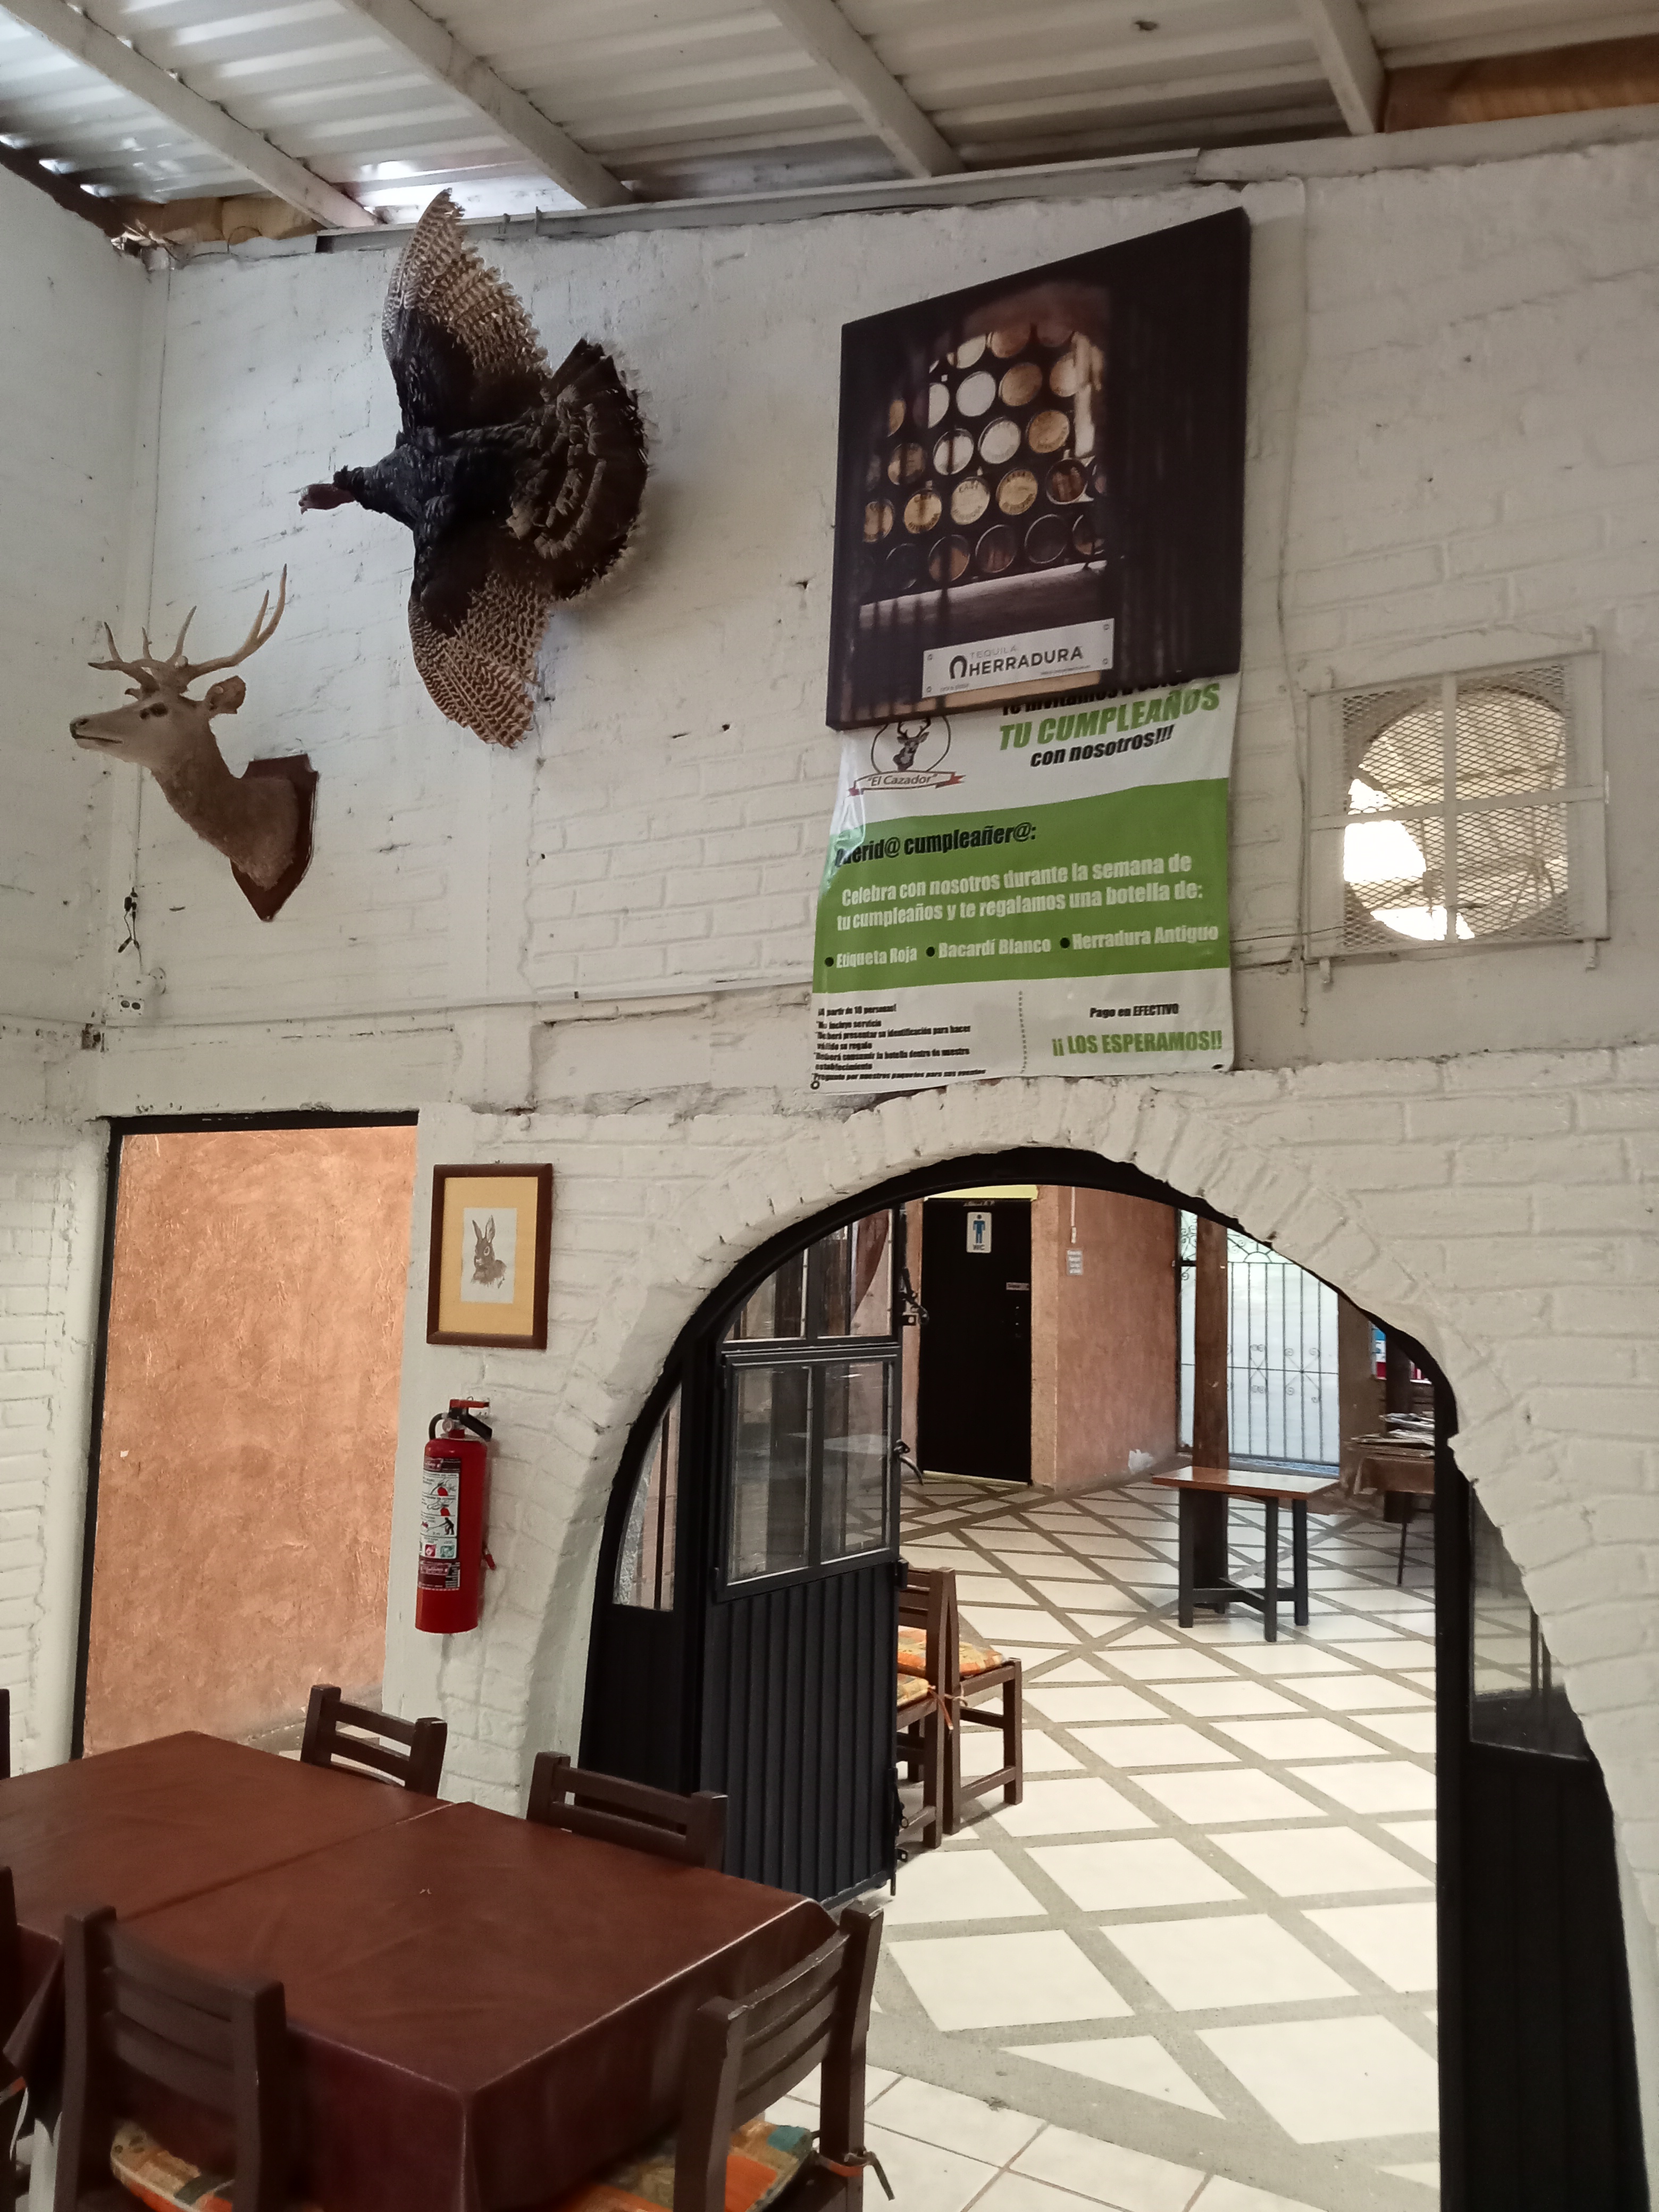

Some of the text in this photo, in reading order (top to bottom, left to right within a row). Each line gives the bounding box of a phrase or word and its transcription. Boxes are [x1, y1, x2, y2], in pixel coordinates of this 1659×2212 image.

[969, 646, 1083, 676] HERRADURA
[970, 644, 1017, 659] TEQUILA
[1000, 683, 1220, 750] TU CUMPLEAÑOS
[1030, 724, 1175, 767] con nosotros!!!
[904, 822, 1036, 855] cumpleañer@:
[842, 853, 1192, 906] Celebra con nosotros durante la semana de
[837, 880, 1203, 931] tu cumpleaños y te regalamos una botella de:
[836, 924, 1218, 968] Etiqueta Roja Bacardí Blanco Herradura Antiguo
[1090, 1003, 1179, 1018] Pago en EFECTIVO
[1067, 1035, 1098, 1054] LOS
[1102, 1030, 1222, 1053] ESPERAMOS!!
